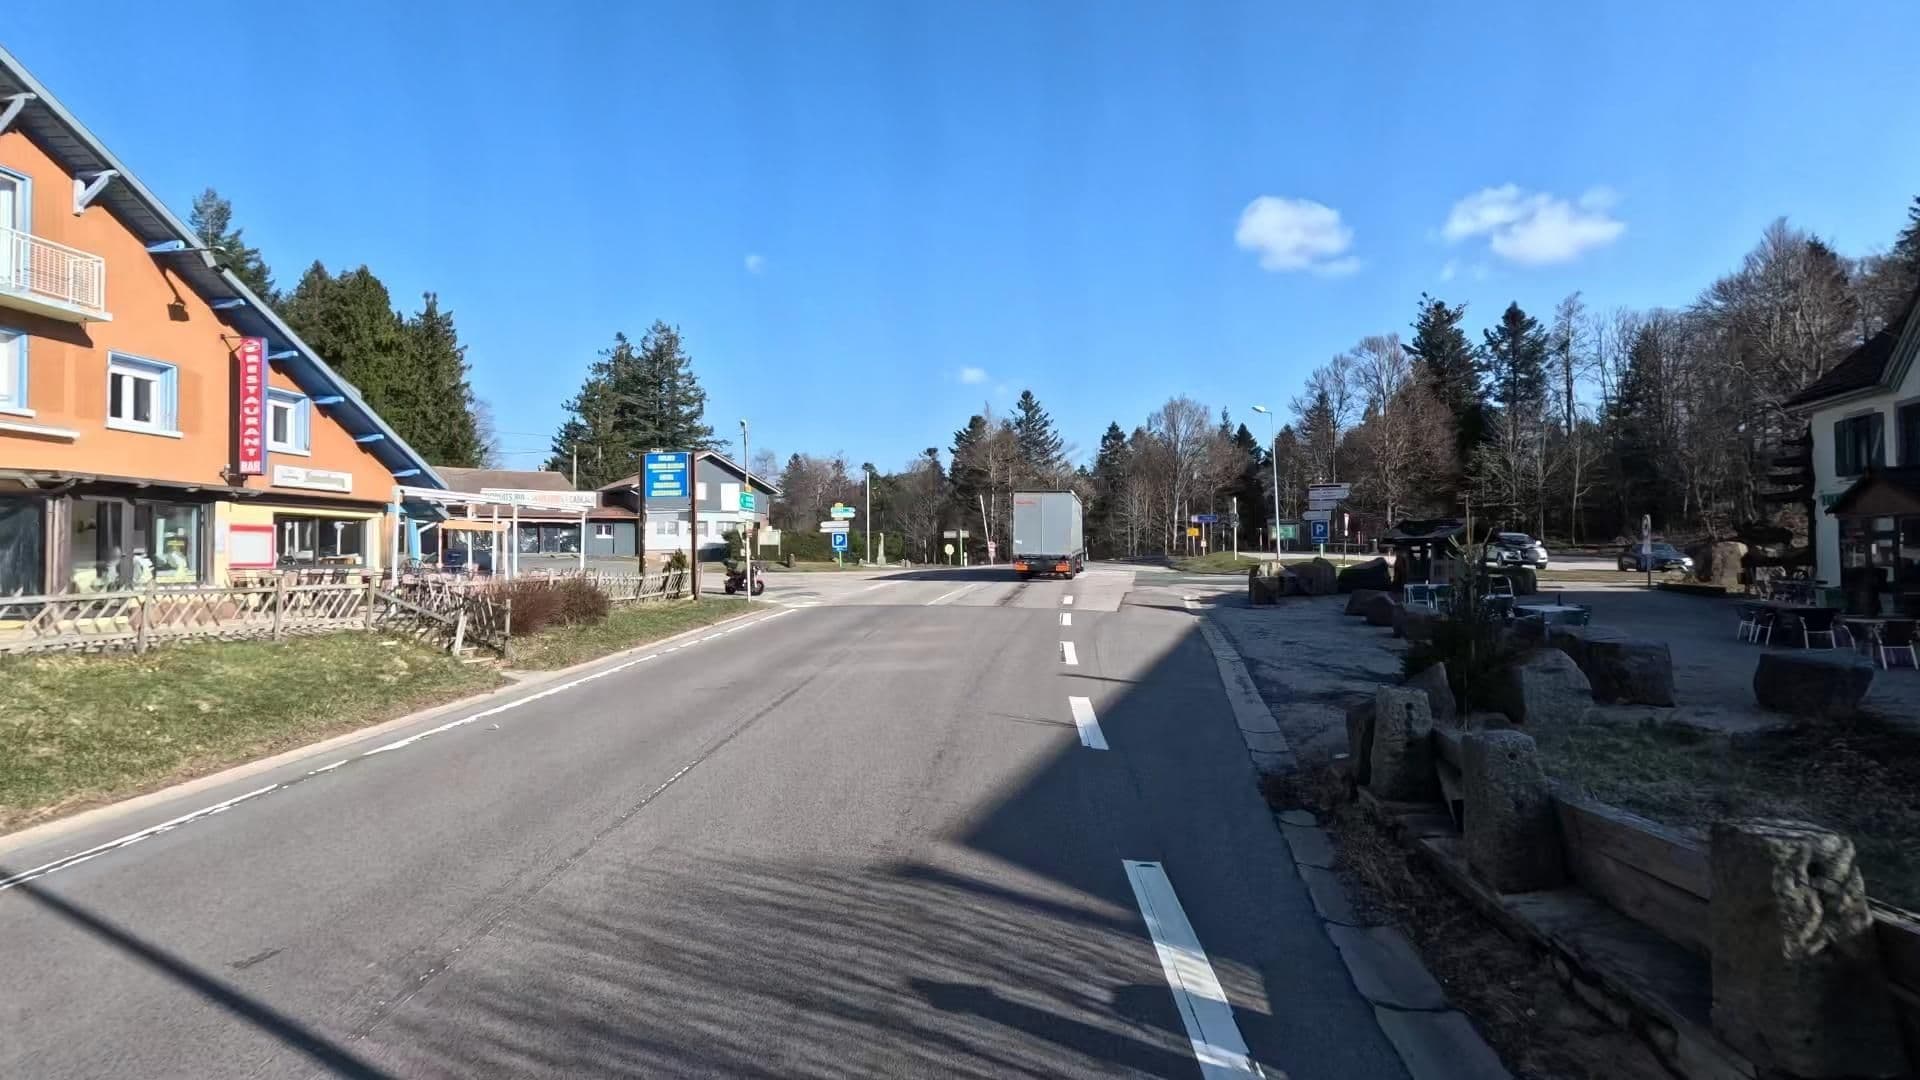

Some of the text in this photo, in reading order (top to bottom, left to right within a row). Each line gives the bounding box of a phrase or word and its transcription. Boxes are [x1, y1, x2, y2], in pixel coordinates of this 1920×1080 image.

[243, 354, 261, 457] RESTAURANT
[240, 460, 262, 474] BAR
[1316, 524, 1324, 535] P
[836, 535, 844, 544] P
